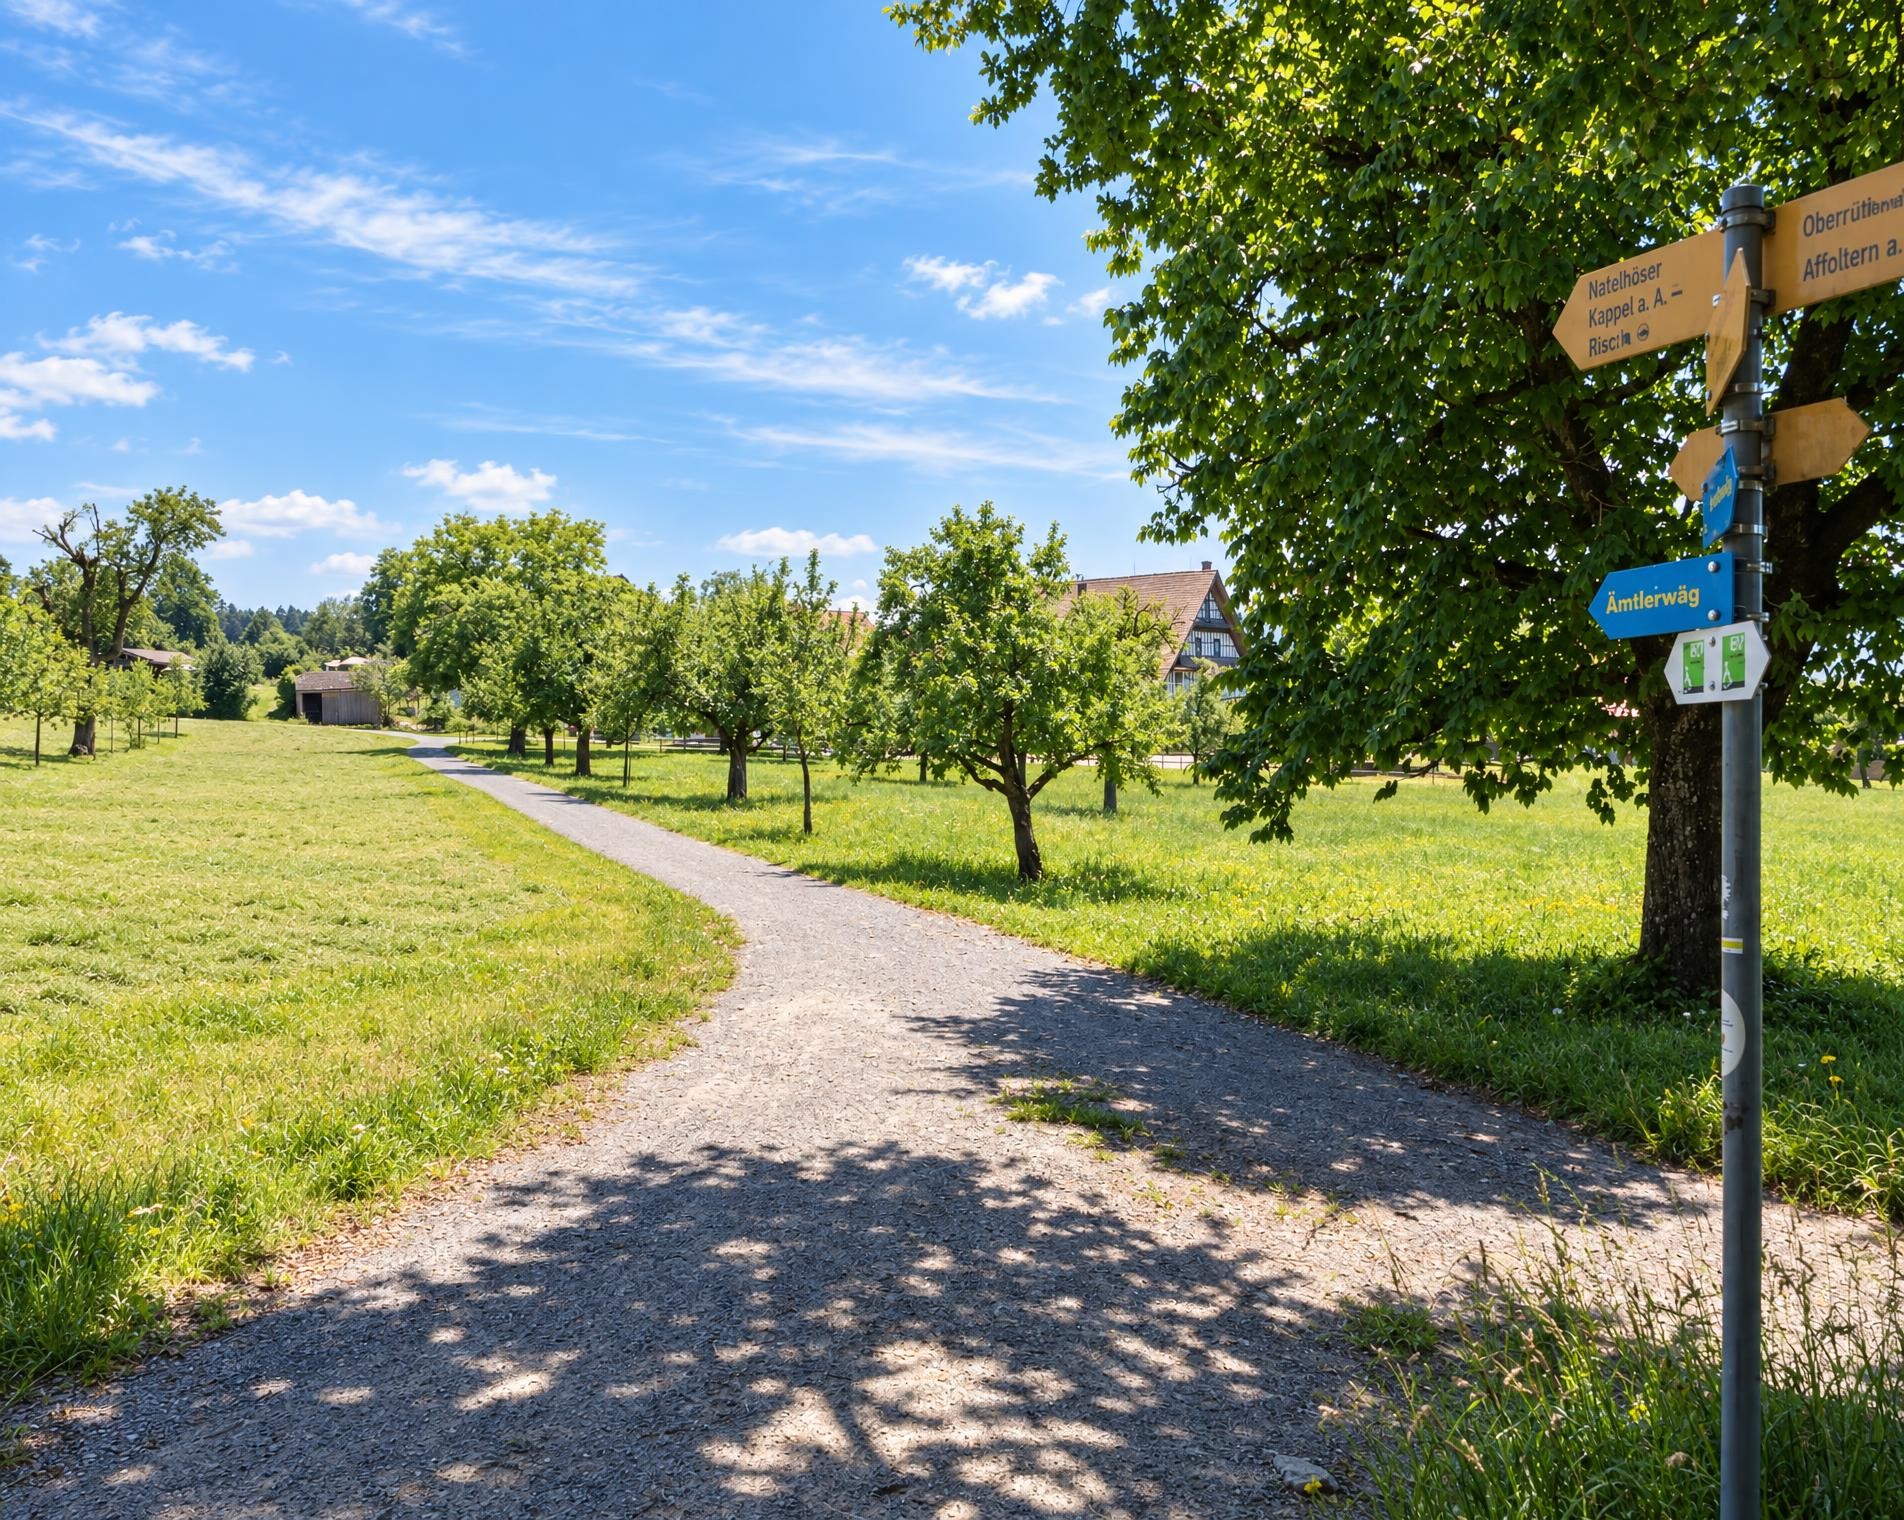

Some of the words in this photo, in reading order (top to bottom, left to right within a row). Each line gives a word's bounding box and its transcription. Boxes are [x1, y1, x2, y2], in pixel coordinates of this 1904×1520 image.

[1803, 243, 1879, 282] Affoltern
[1887, 238, 1902, 257] a.
[1589, 262, 1662, 300] Natelhöser
[1589, 296, 1633, 328] Kappel
[1638, 298, 1649, 313] a.
[1653, 287, 1667, 309] A.
[1606, 585, 1700, 615] Ämtlerwäg
